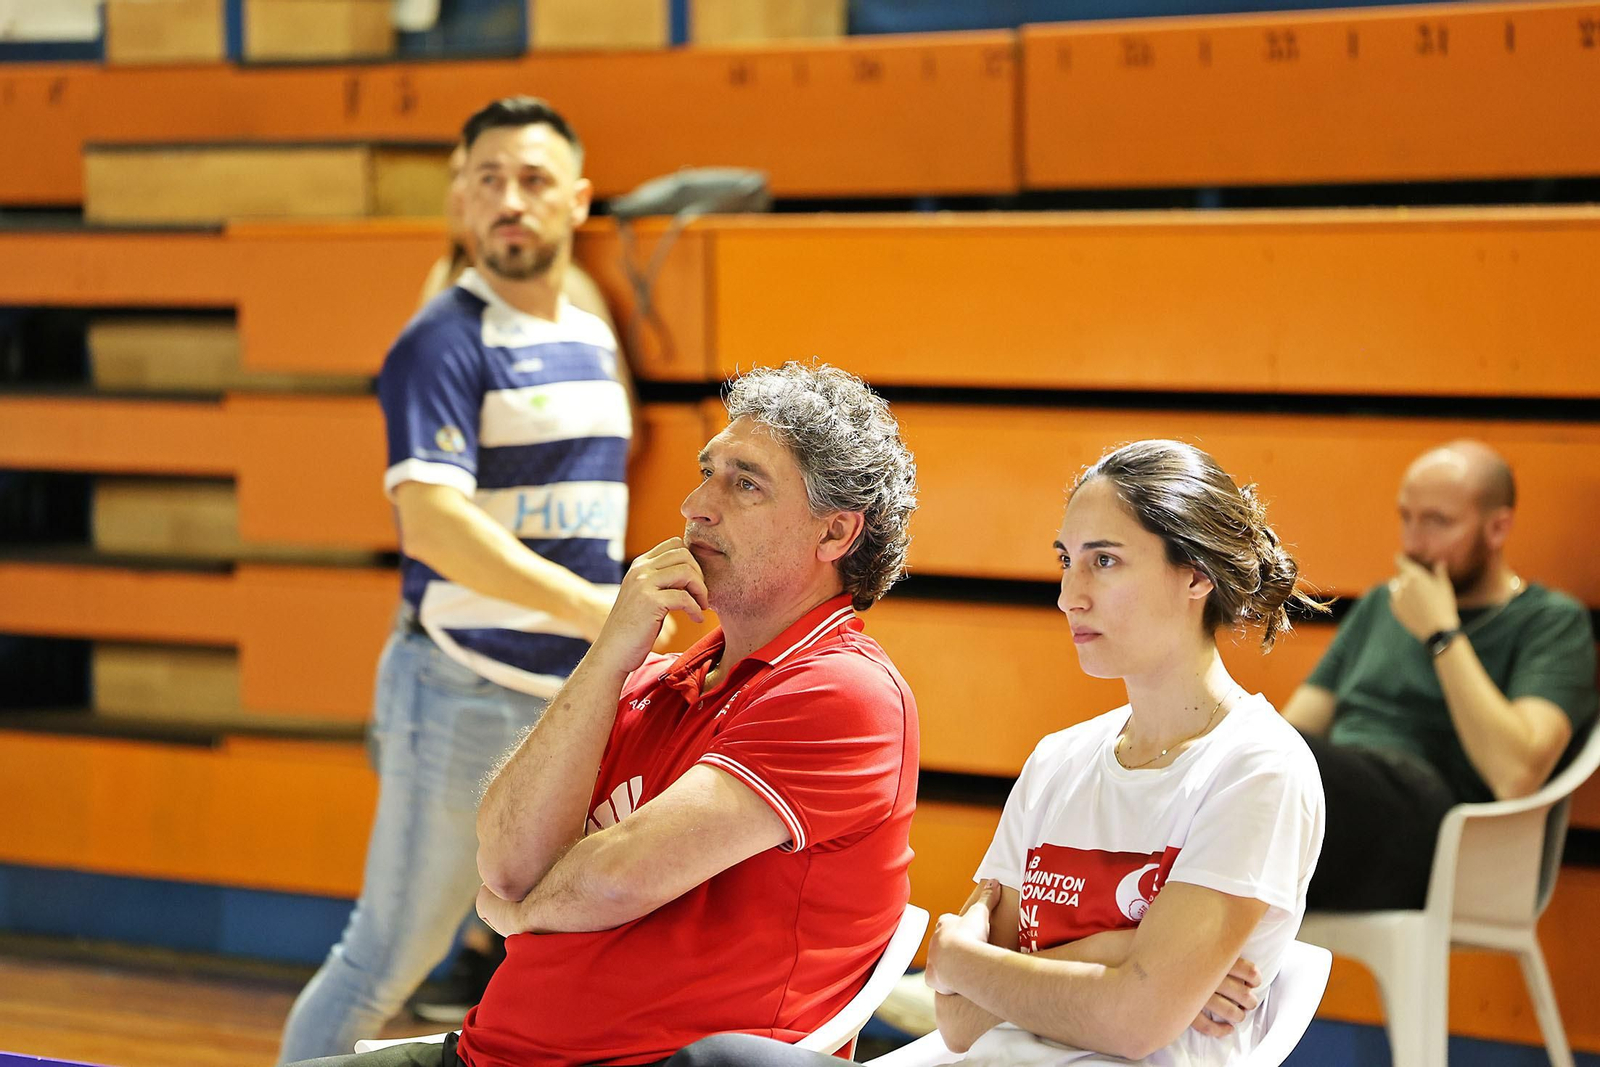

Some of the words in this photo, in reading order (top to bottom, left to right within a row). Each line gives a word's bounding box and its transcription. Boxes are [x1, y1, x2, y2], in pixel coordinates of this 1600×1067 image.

[1028, 856, 1041, 869] B
[1025, 870, 1085, 892] MINTON
[1022, 884, 1079, 907] ONADA
